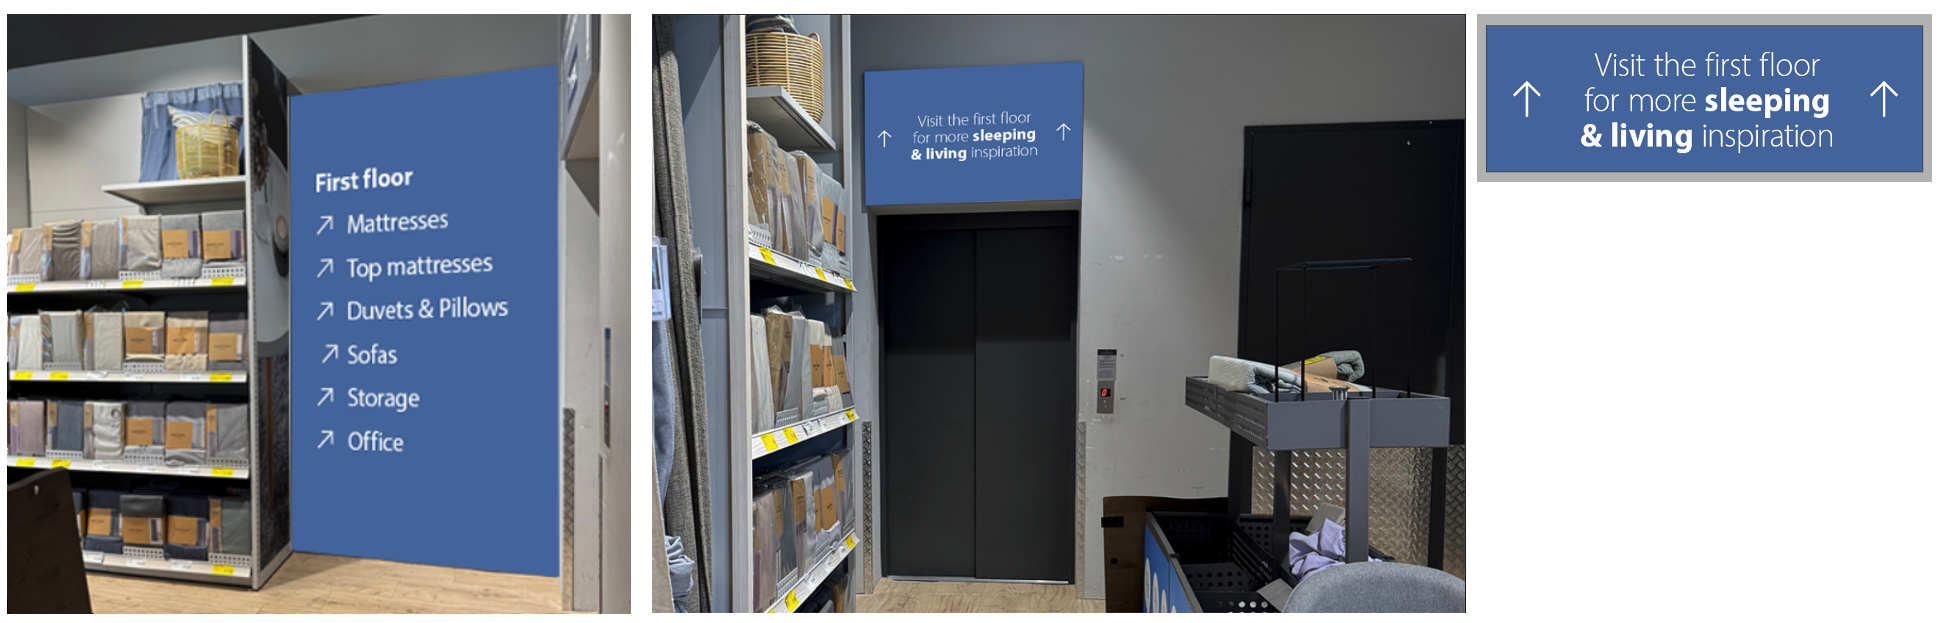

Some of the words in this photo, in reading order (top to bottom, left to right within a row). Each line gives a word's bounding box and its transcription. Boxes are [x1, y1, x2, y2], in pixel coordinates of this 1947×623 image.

[1594, 52, 1646, 77] Visit
[1653, 52, 1697, 77] the
[1704, 51, 1752, 77] first
[1759, 51, 1821, 77] floor
[1584, 86, 1620, 112] for
[1629, 93, 1697, 112] more
[1704, 87, 1830, 119] sleeping
[917, 114, 943, 128] Visit
[947, 113, 969, 127] the
[973, 112, 996, 126] first
[1000, 110, 1032, 125] floor
[912, 130, 930, 144] for
[935, 131, 969, 143] more
[972, 128, 1036, 144] sleeping
[1580, 123, 1603, 148] &
[1611, 122, 1693, 154] living
[1702, 124, 1834, 154] inspiration
[910, 148, 922, 161] &
[926, 147, 967, 162] living
[971, 145, 1038, 161] inspiration
[315, 171, 360, 193] First
[362, 167, 414, 190] floor
[347, 213, 449, 234] Mattresses
[346, 258, 383, 283] Top
[387, 256, 493, 277] mattresses
[347, 300, 414, 321] Duvets
[418, 298, 435, 319] &
[439, 296, 509, 318] Pillows
[347, 343, 398, 365] Sofas
[347, 387, 420, 413] Storage
[347, 430, 404, 452] Office
